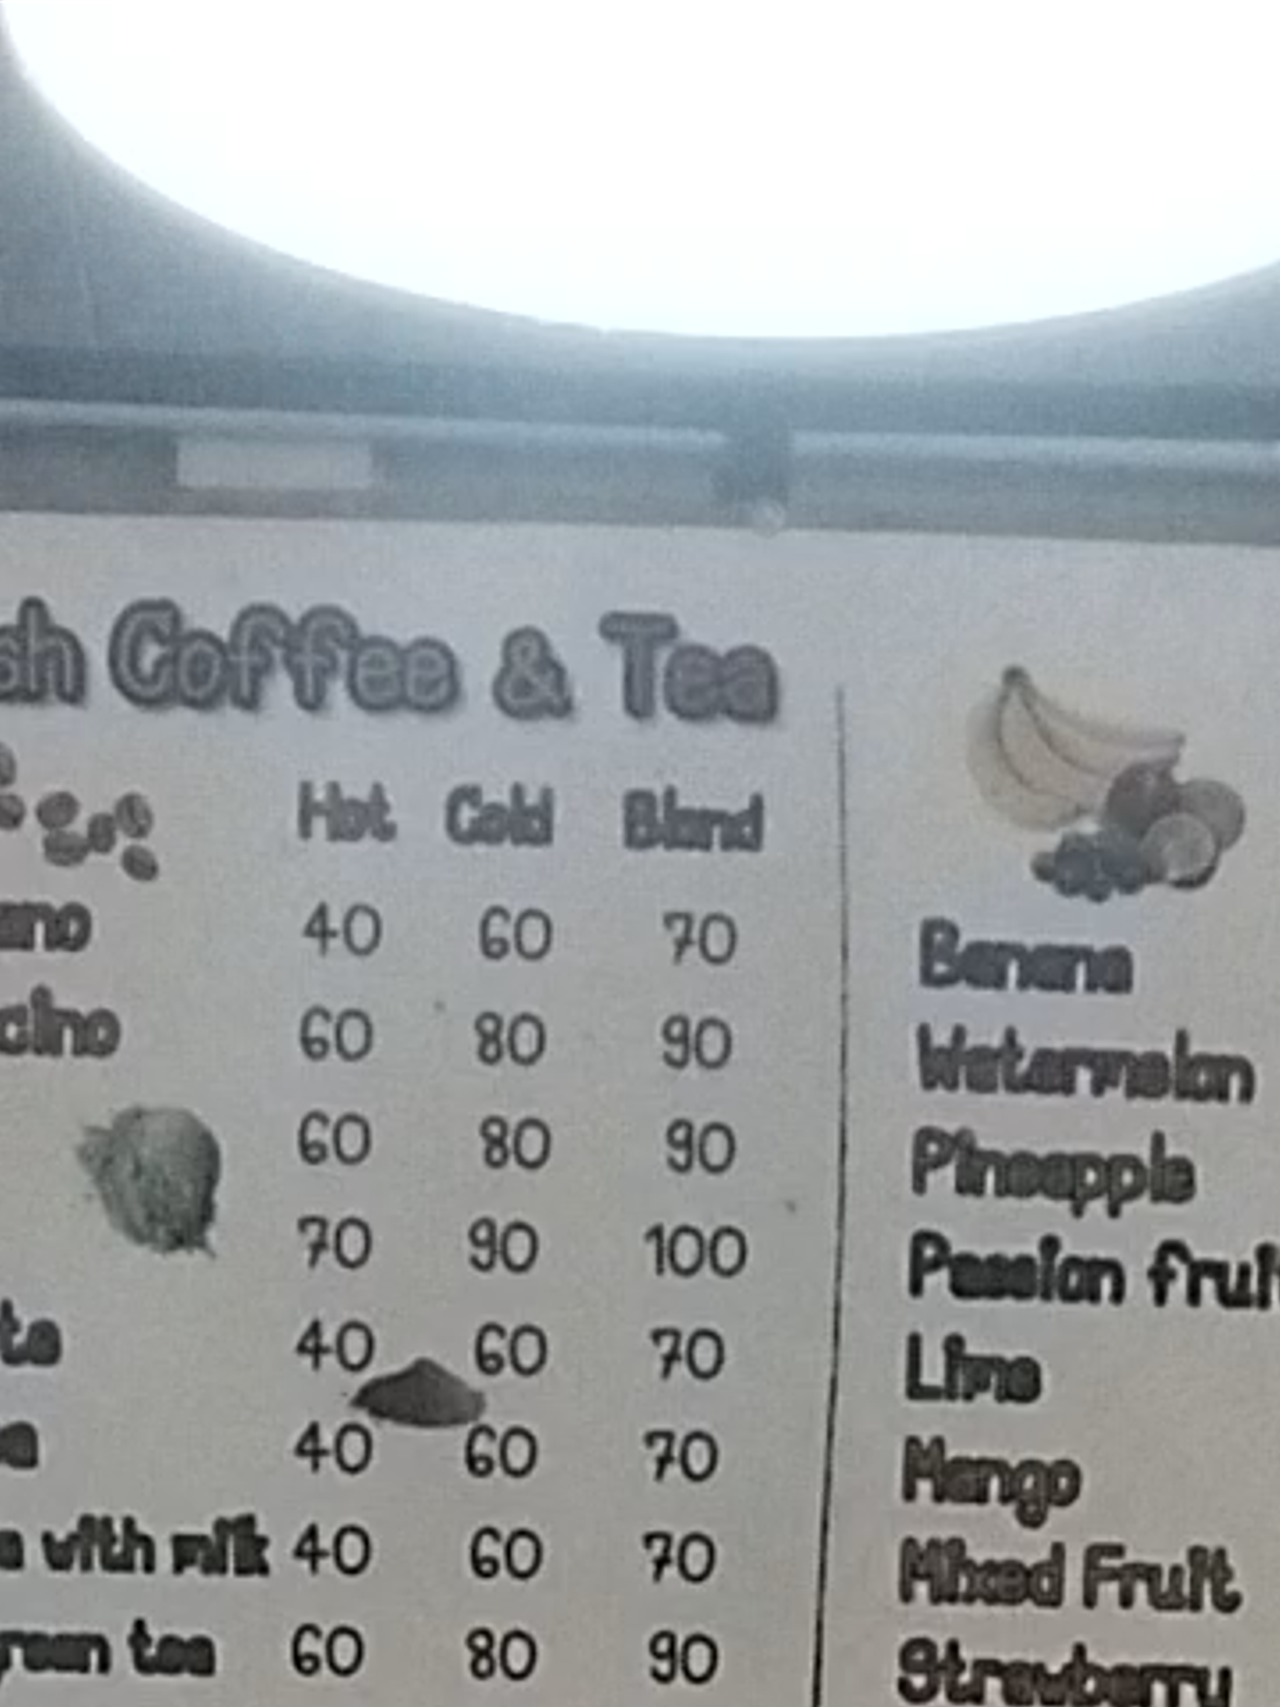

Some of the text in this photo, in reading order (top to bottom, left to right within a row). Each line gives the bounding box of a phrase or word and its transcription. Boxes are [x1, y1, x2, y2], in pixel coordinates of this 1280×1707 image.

[108, 599, 463, 717] Coffee
[492, 626, 575, 722] &
[599, 611, 782, 728] Tea
[445, 782, 554, 847] Cold
[303, 902, 382, 957] 40
[479, 905, 553, 961] 60
[663, 911, 738, 966] 70
[919, 917, 1133, 995] Banana
[300, 1005, 373, 1062] 60
[474, 1011, 546, 1067] 80
[661, 1013, 732, 1070] 90
[916, 1022, 1256, 1105] Watermelon
[298, 1110, 372, 1166] 60
[479, 1115, 552, 1171] 80
[666, 1118, 737, 1175] 90
[912, 1126, 1197, 1219] Pineapple
[297, 1215, 373, 1271] 70
[468, 1217, 539, 1274] 90
[644, 1223, 748, 1279] 100
[908, 1229, 1126, 1307] Passion
[295, 1318, 375, 1374] 40
[474, 1322, 548, 1378] 60
[650, 1327, 725, 1382] 70
[905, 1331, 1042, 1404] Lime
[293, 1421, 373, 1476] 40
[463, 1423, 539, 1480] 60
[643, 1430, 719, 1483] 70
[902, 1435, 1083, 1530] Mango
[41, 1513, 156, 1575] with
[170, 1513, 270, 1578] milk
[292, 1522, 372, 1577] 40
[470, 1525, 543, 1581] 60
[642, 1531, 716, 1584] 70
[898, 1536, 1066, 1609] Mixed
[1082, 1542, 1243, 1614] Fruit
[127, 1617, 216, 1678] tea
[291, 1623, 365, 1678] 60
[465, 1627, 538, 1682] 80
[649, 1630, 719, 1685] 90
